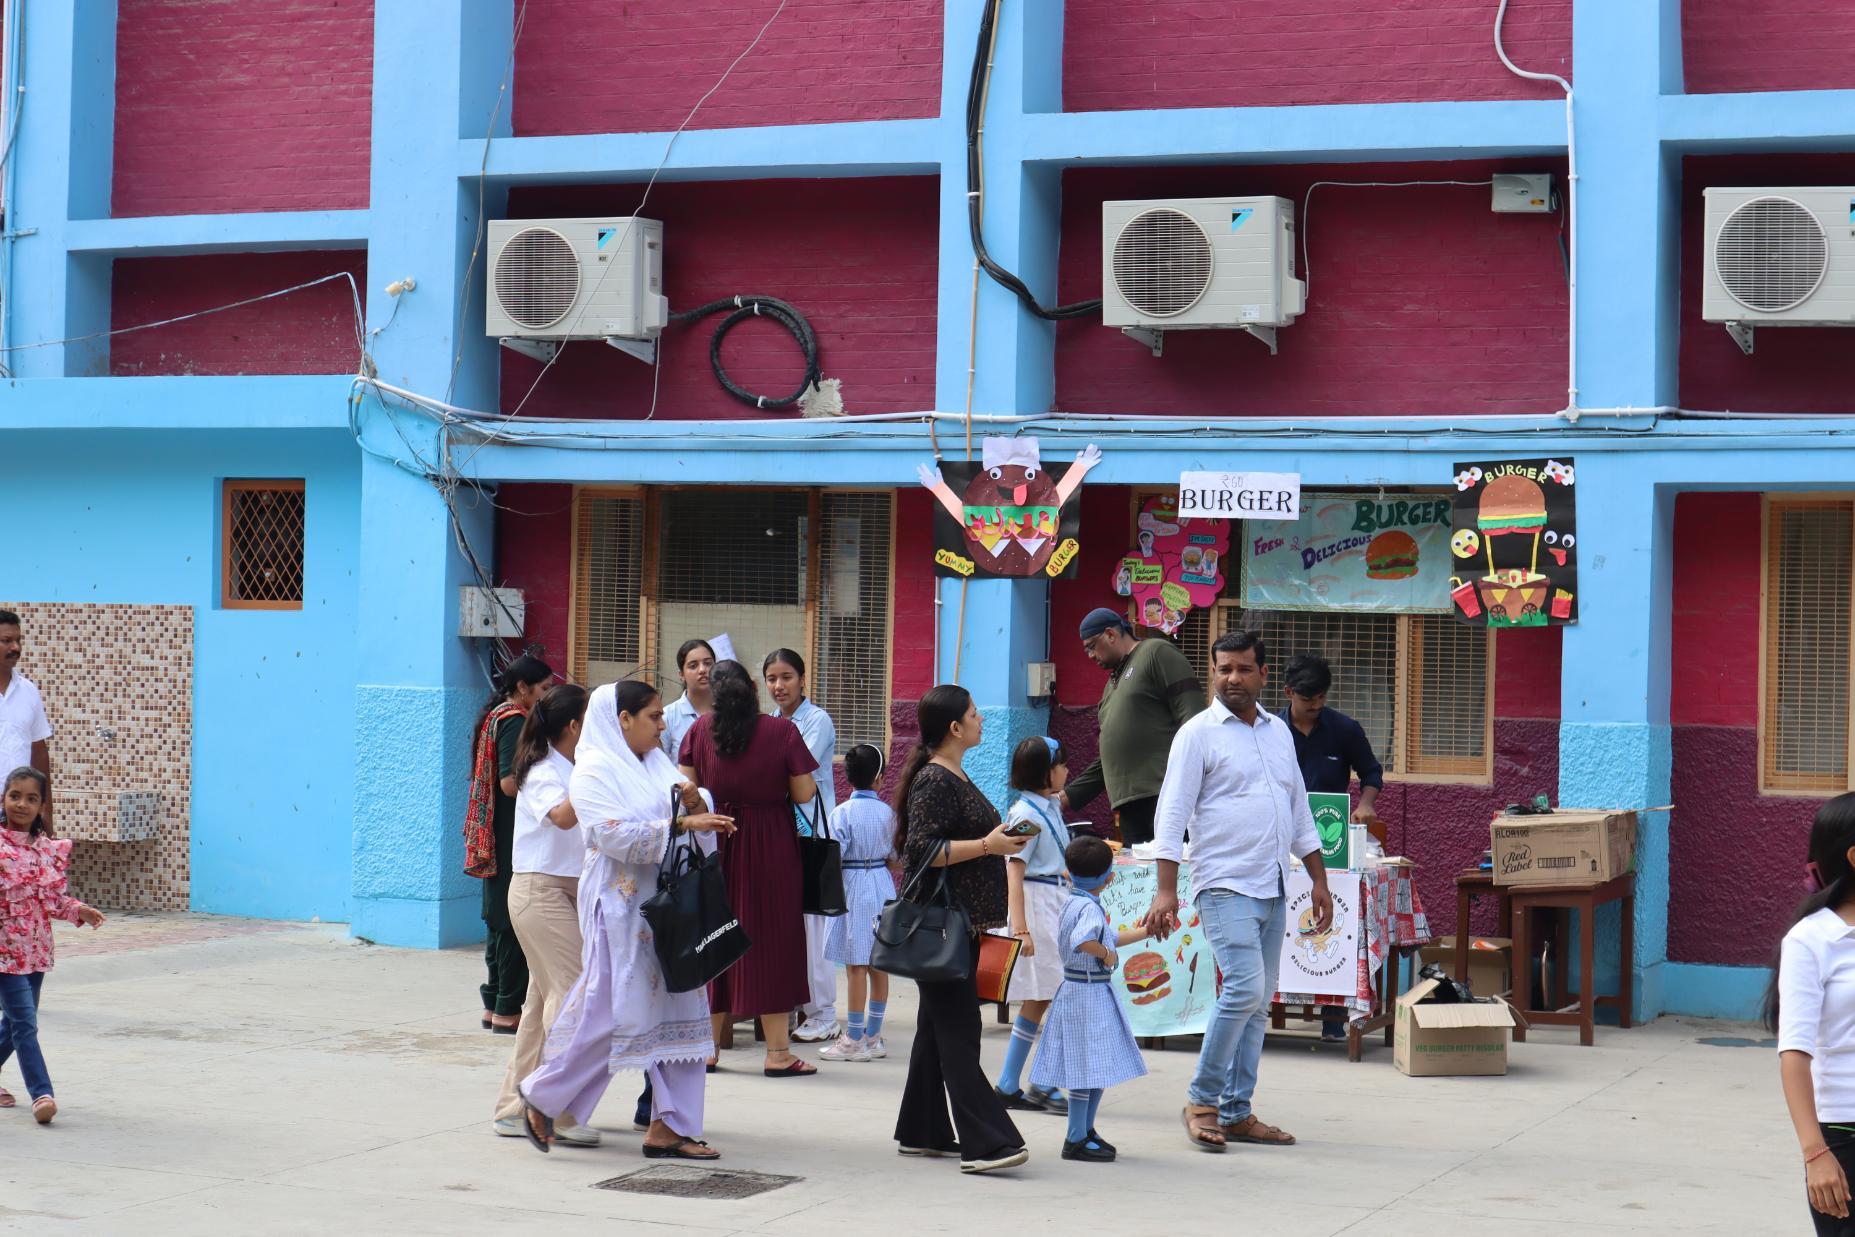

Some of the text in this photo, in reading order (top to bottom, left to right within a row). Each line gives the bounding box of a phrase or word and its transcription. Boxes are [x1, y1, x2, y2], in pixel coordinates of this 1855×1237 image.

[1484, 464, 1547, 484] BURGER
[1180, 488, 1293, 513] BURGER
[1352, 499, 1451, 533] BURGER
[938, 551, 972, 573] YUMMY
[1049, 540, 1077, 573] BURGER
[1301, 534, 1373, 570] DELICIOUS
[1507, 846, 1530, 862] Red
[1502, 859, 1532, 875] Label
[1290, 891, 1310, 911] SPECI
[1291, 955, 1347, 977] DELICIOUS BURGER
